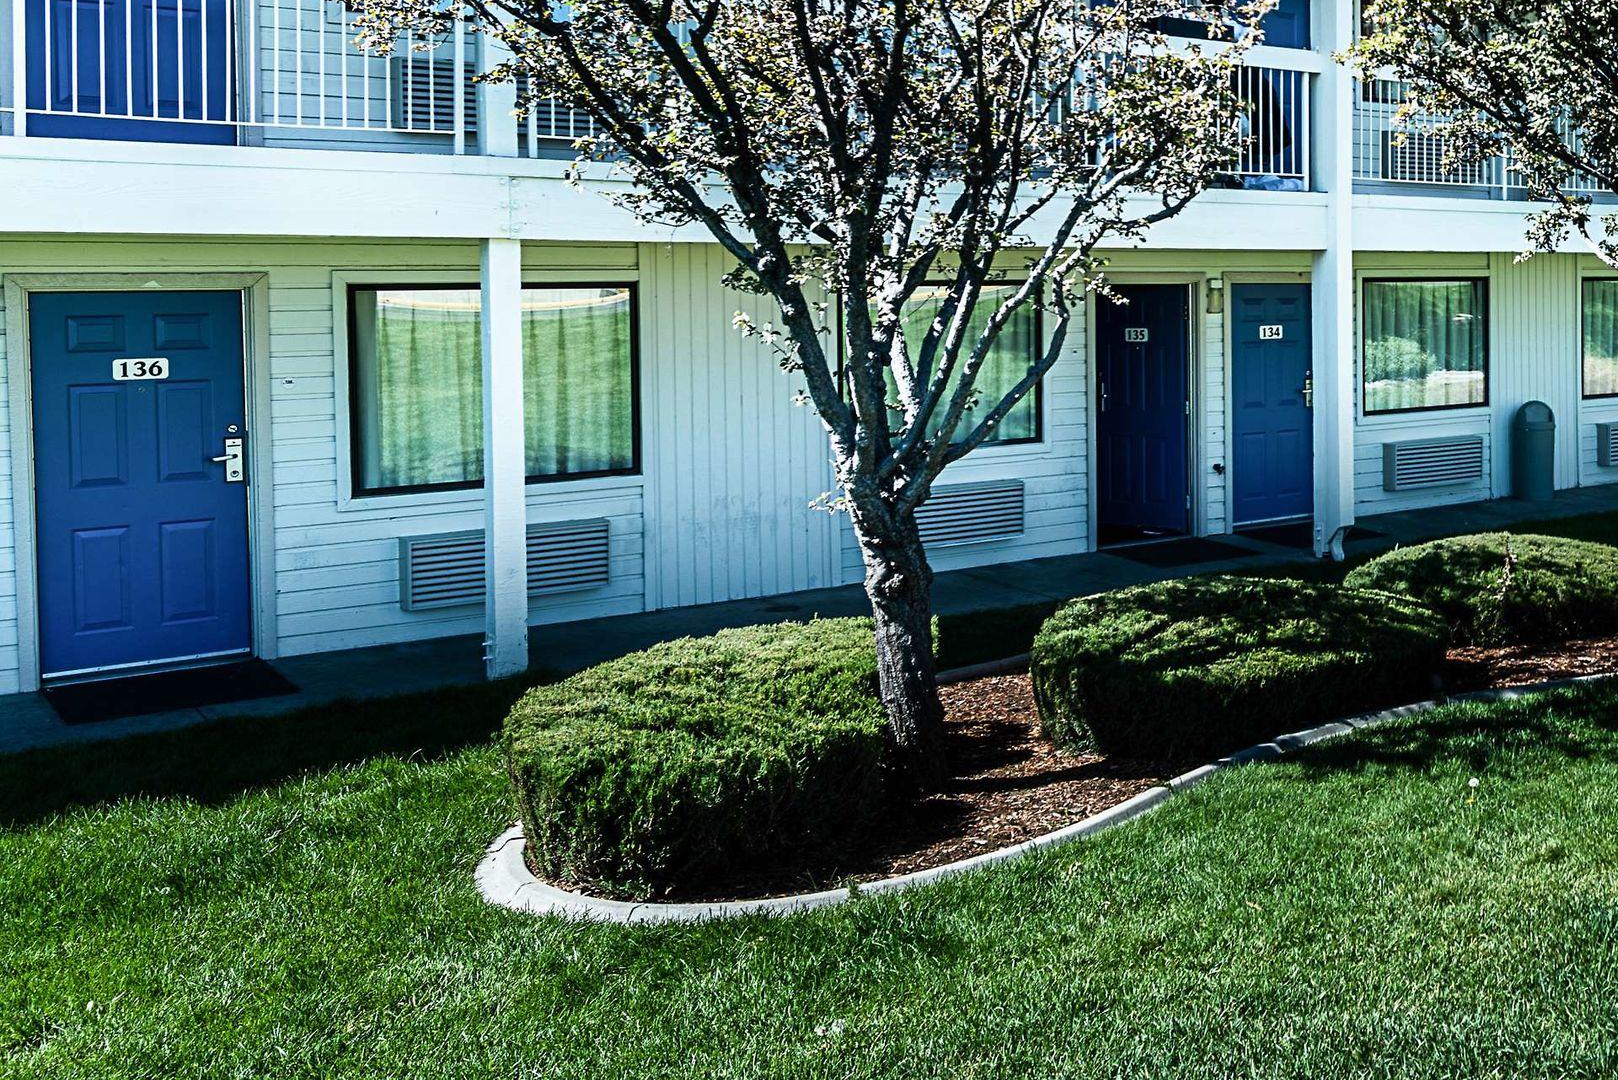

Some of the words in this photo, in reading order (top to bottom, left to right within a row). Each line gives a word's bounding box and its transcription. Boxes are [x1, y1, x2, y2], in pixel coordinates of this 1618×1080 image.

[1127, 329, 1145, 341] 135
[1262, 326, 1280, 338] 134
[119, 360, 163, 378] 136
